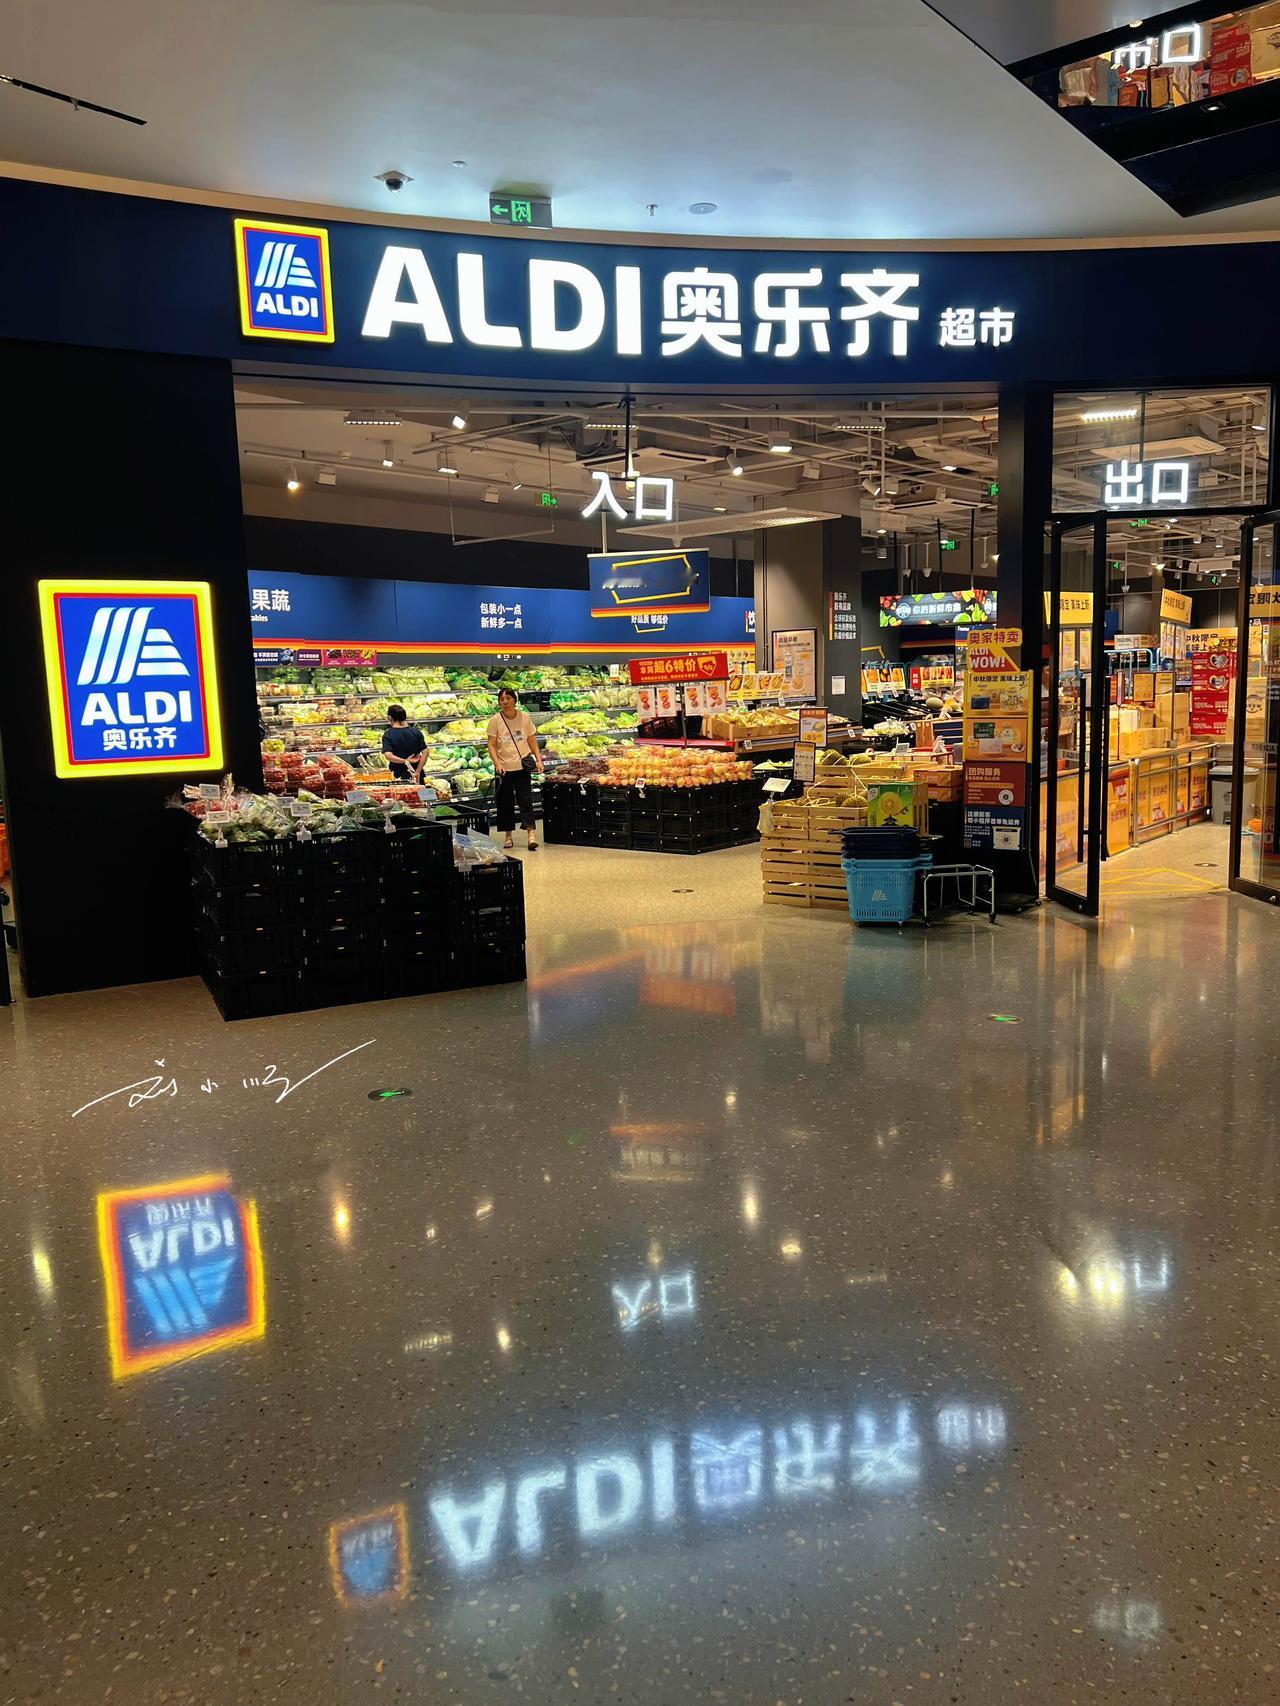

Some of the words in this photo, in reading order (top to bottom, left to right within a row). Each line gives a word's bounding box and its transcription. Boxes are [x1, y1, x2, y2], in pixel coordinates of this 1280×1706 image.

[256, 292, 318, 318] ALDI
[939, 307, 1015, 347] 超市
[1105, 460, 1189, 504] 出口
[582, 472, 673, 520] 入口
[252, 588, 291, 611] 果蔬
[913, 603, 961, 614] 你的新鲜市集
[480, 603, 522, 615] 包装小一点
[481, 617, 522, 629] 新鲜多一点
[970, 631, 1019, 644] 奥家特卖
[970, 647, 989, 655] ALDI
[970, 656, 1006, 668] WOW!
[81, 691, 192, 726] ALDI
[103, 727, 177, 751] 奥乐齐
[969, 768, 1001, 776] 团购服务
